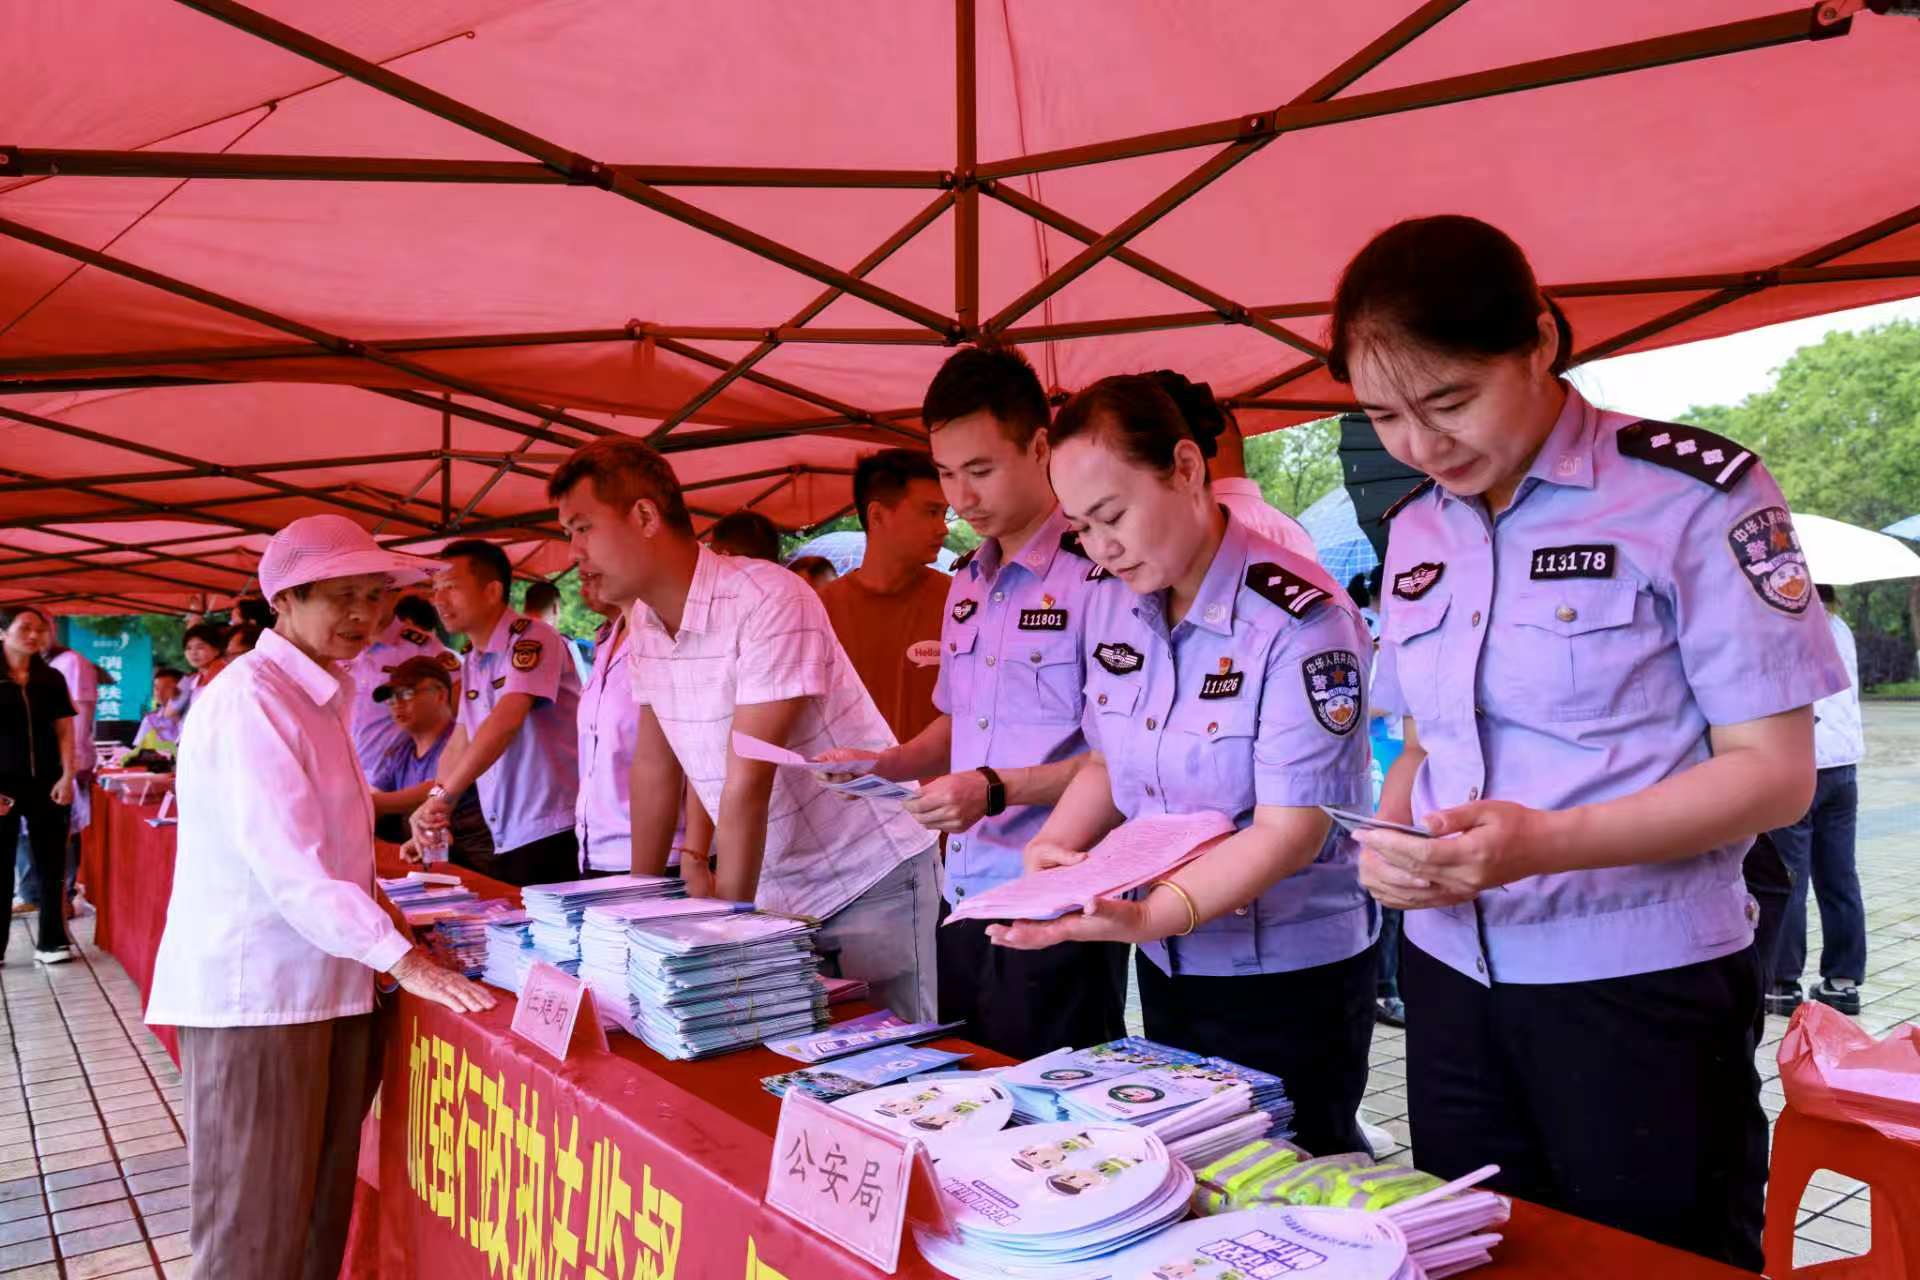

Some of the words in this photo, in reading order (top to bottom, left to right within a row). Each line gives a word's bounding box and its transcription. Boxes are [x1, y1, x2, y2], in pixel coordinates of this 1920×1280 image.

[1535, 551, 1607, 573] 113178
[1022, 613, 1062, 626] 111801
[785, 1129, 884, 1224] 公安局
